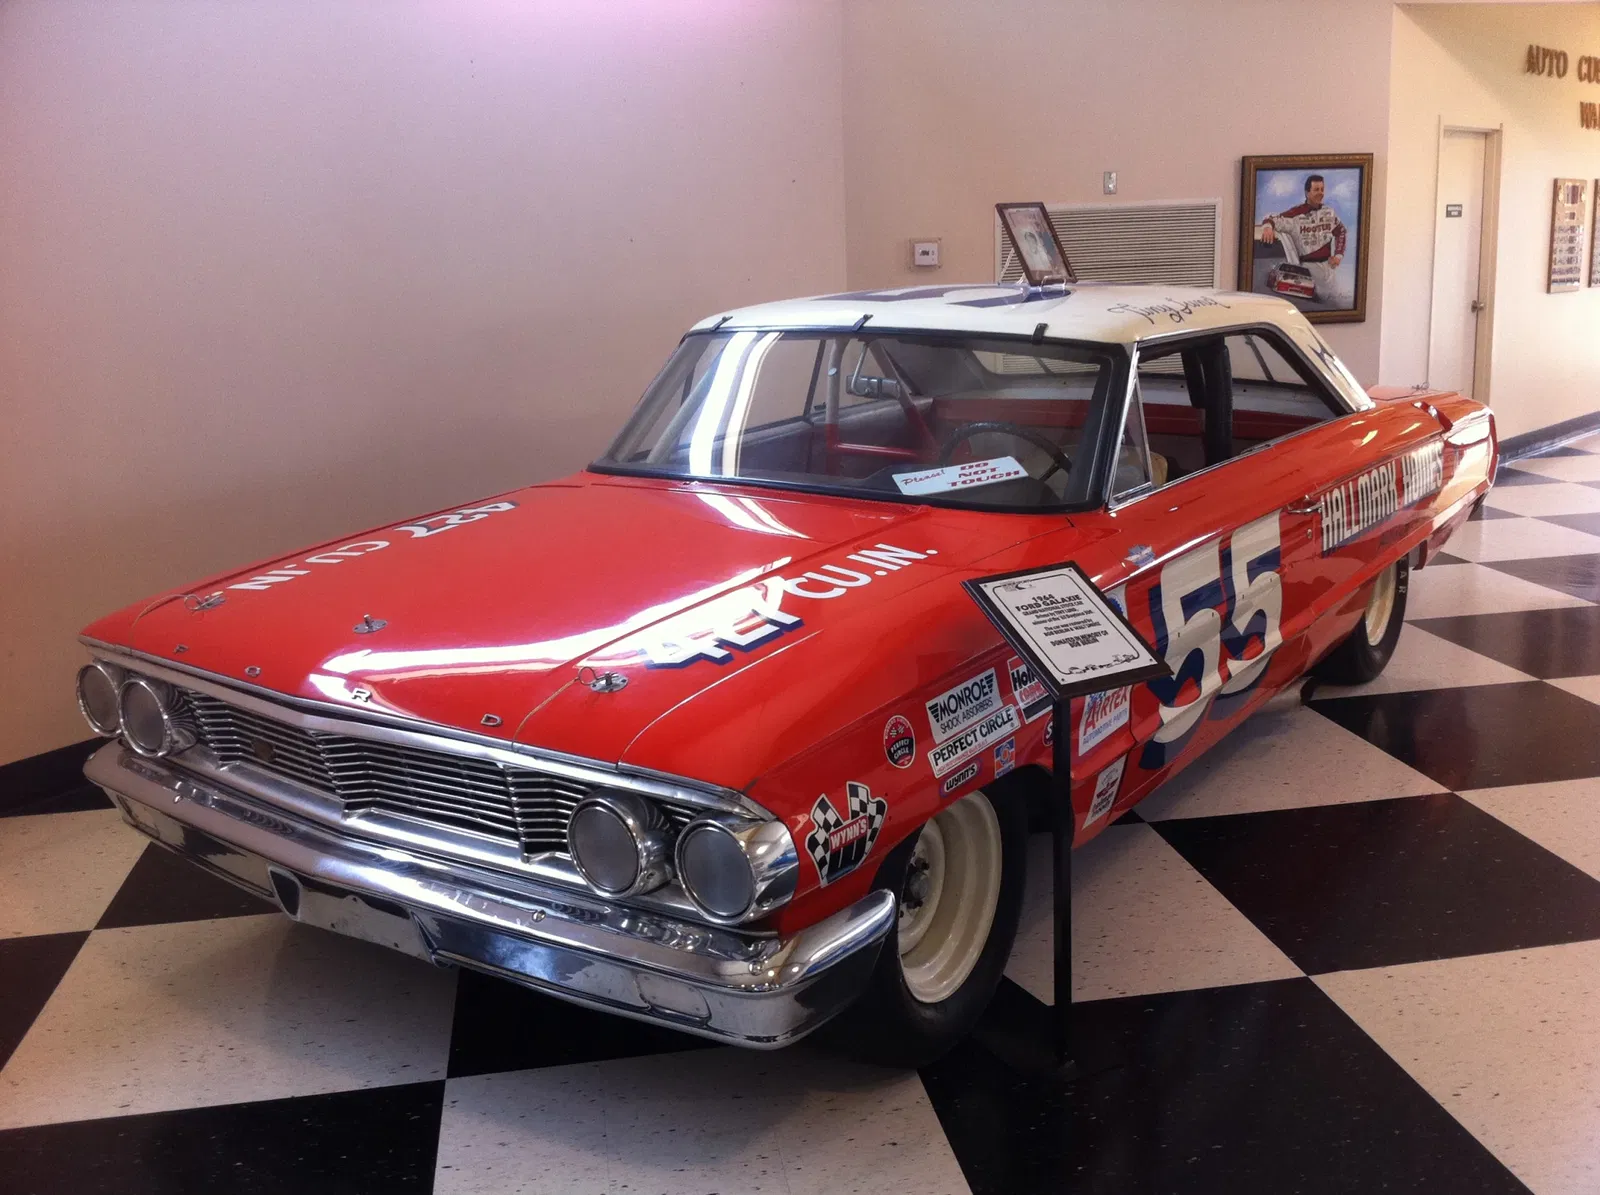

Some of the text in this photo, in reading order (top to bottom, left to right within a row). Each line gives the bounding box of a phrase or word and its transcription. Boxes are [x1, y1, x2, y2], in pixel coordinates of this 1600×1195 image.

[1525, 44, 1568, 79] AUTO
[900, 469, 946, 486] Please!
[947, 470, 1020, 487] TOUCH
[958, 466, 1000, 478] NOT
[960, 462, 989, 470] DO
[1320, 459, 1399, 552] HALLMARK
[1015, 594, 1082, 612] FORD GALAXIE
[1032, 594, 1055, 603] 1964
[1149, 509, 1284, 746] 55
[938, 679, 989, 721] MONROE
[939, 698, 994, 735] SHOCK ABSORBERS
[932, 727, 978, 767] PERFECT
[979, 707, 1014, 738] CIRCLE
[829, 817, 869, 851] WYNN'S
